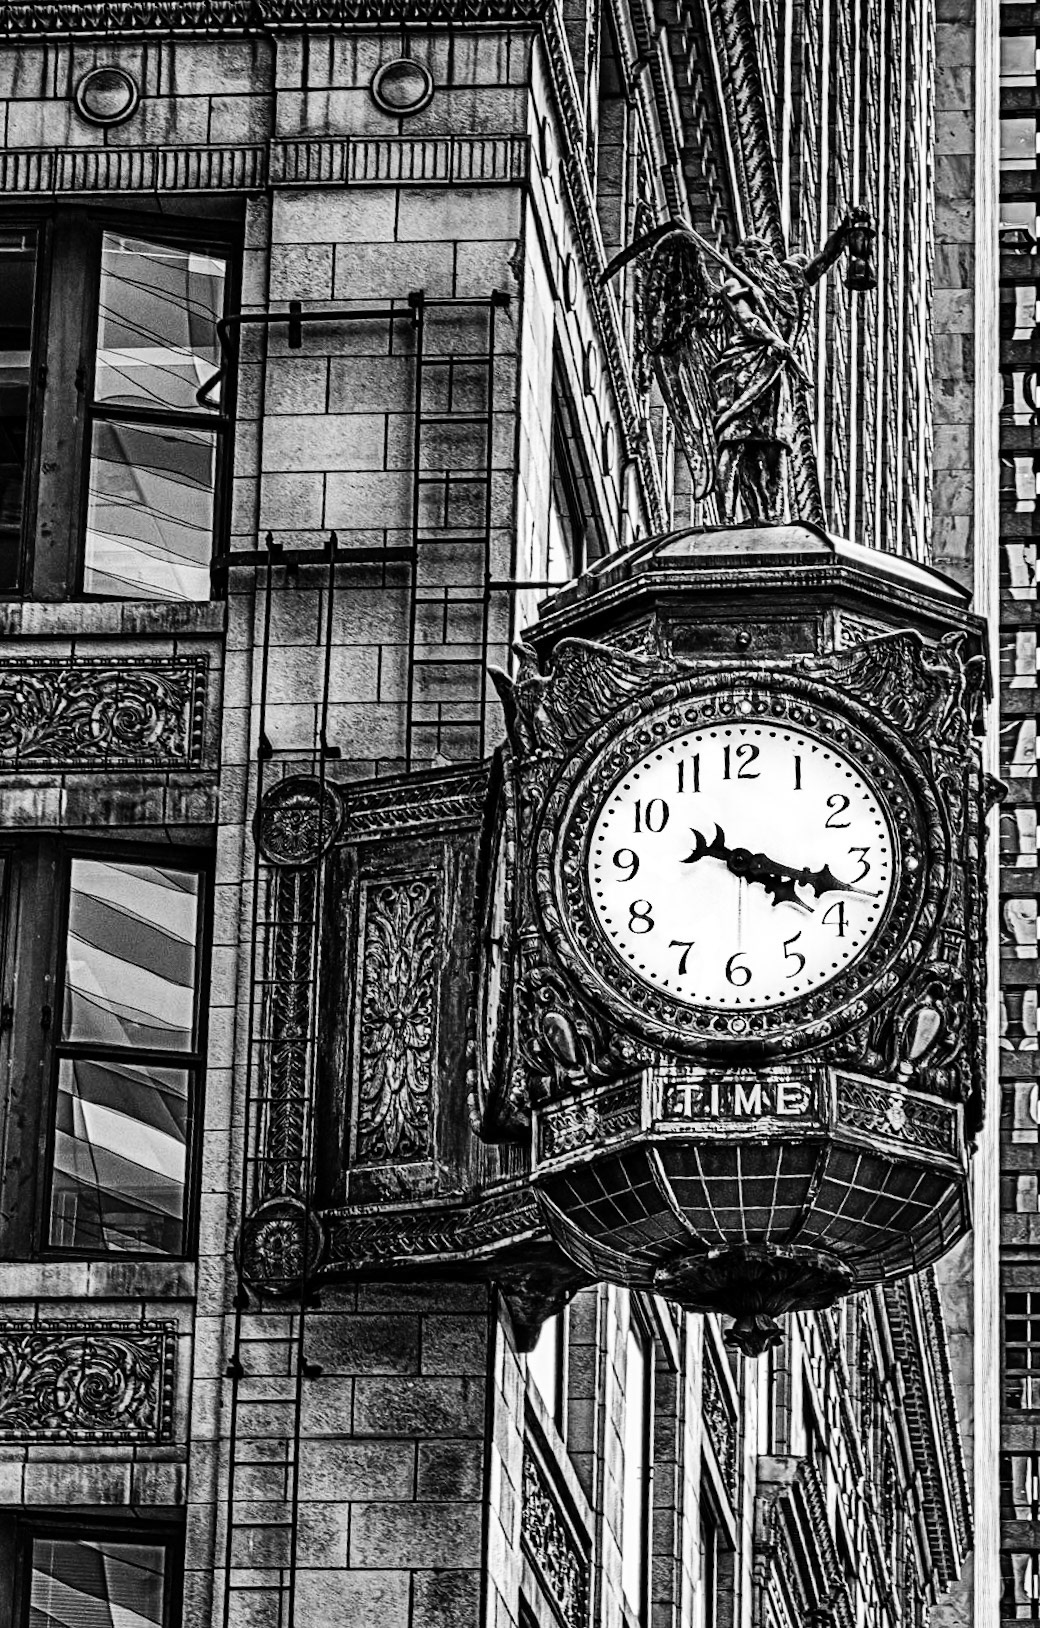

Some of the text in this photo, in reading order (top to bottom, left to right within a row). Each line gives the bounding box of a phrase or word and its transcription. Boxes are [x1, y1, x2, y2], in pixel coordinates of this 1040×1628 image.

[676, 752, 702, 793] 11
[723, 743, 761, 780] 12
[792, 755, 803, 791] 1
[633, 798, 670, 833] 10
[824, 794, 852, 829] 2
[612, 848, 640, 883] 9
[847, 846, 871, 884] 3
[627, 899, 655, 934] 8
[821, 900, 849, 938] 4
[668, 939, 696, 976] 7
[725, 952, 752, 987] 6
[783, 930, 806, 979] 5
[676, 1082, 803, 1118] TIME
